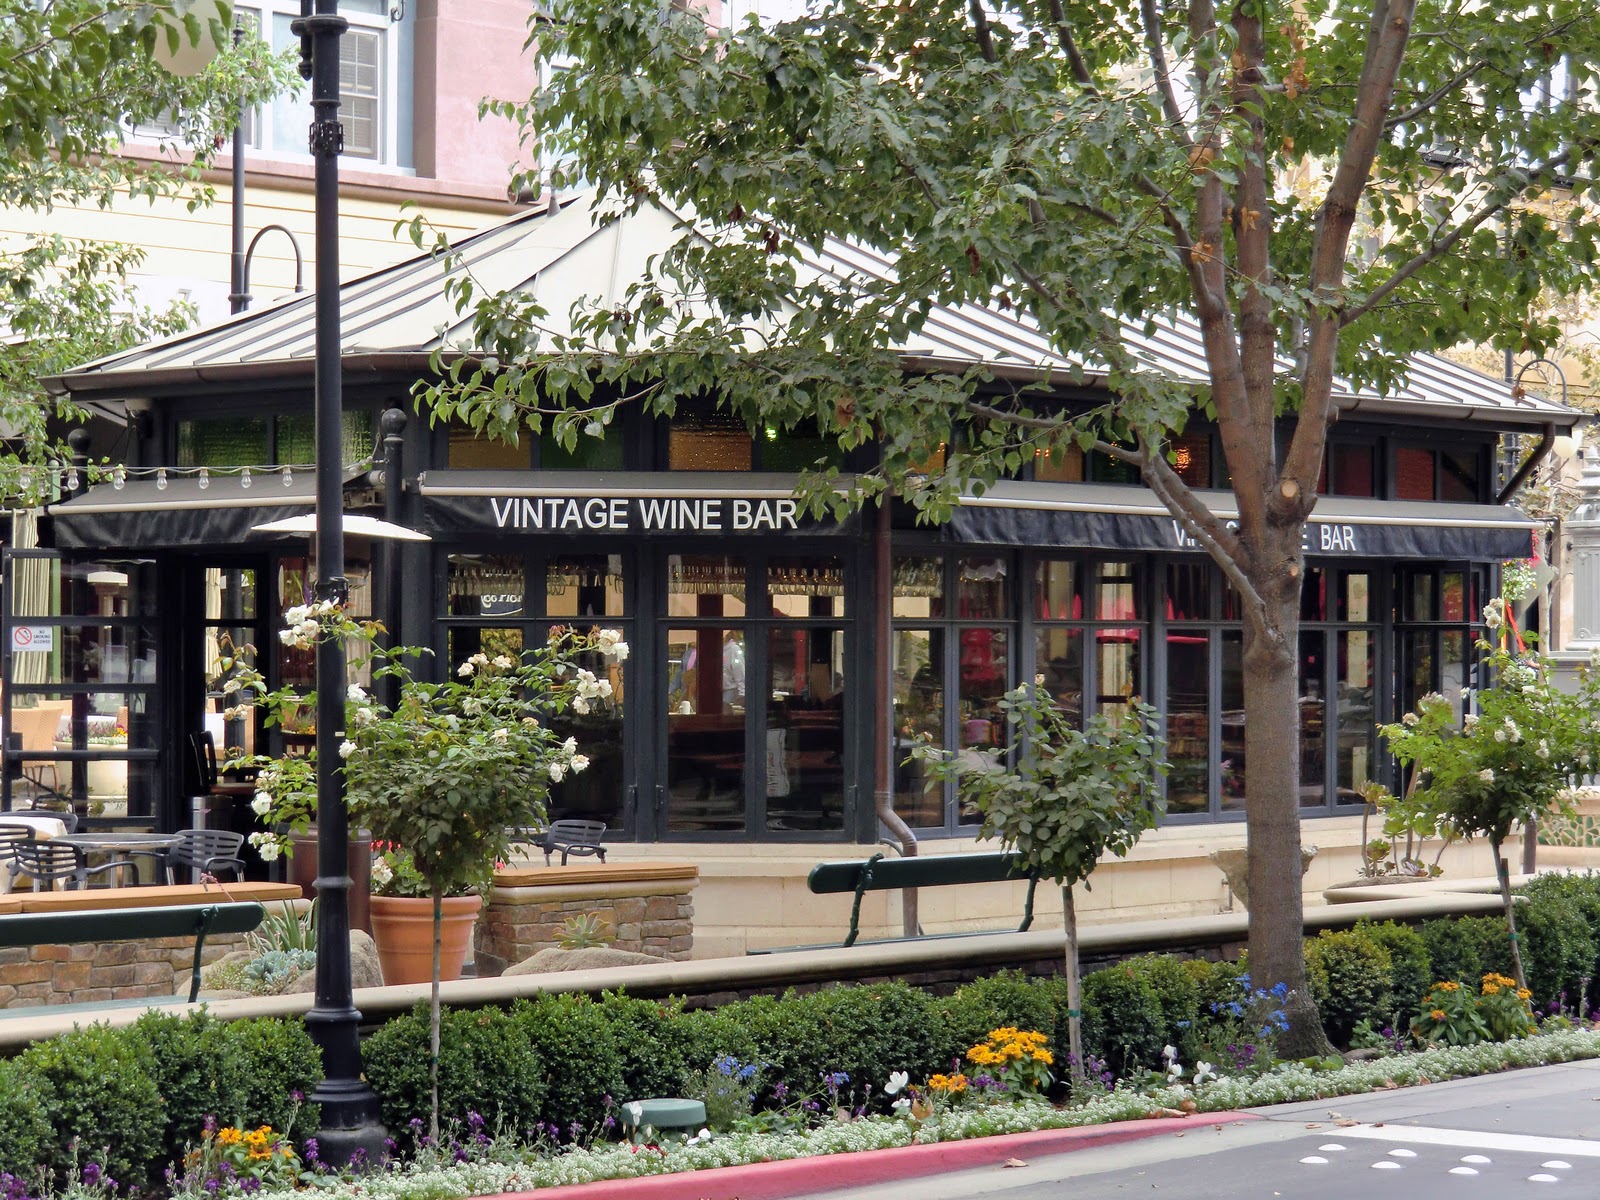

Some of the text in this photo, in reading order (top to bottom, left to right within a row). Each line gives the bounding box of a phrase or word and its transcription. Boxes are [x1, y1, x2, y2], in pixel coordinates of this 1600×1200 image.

[490, 498, 798, 530] VINTAGE WINE BAR
[1320, 524, 1357, 551] BAR
